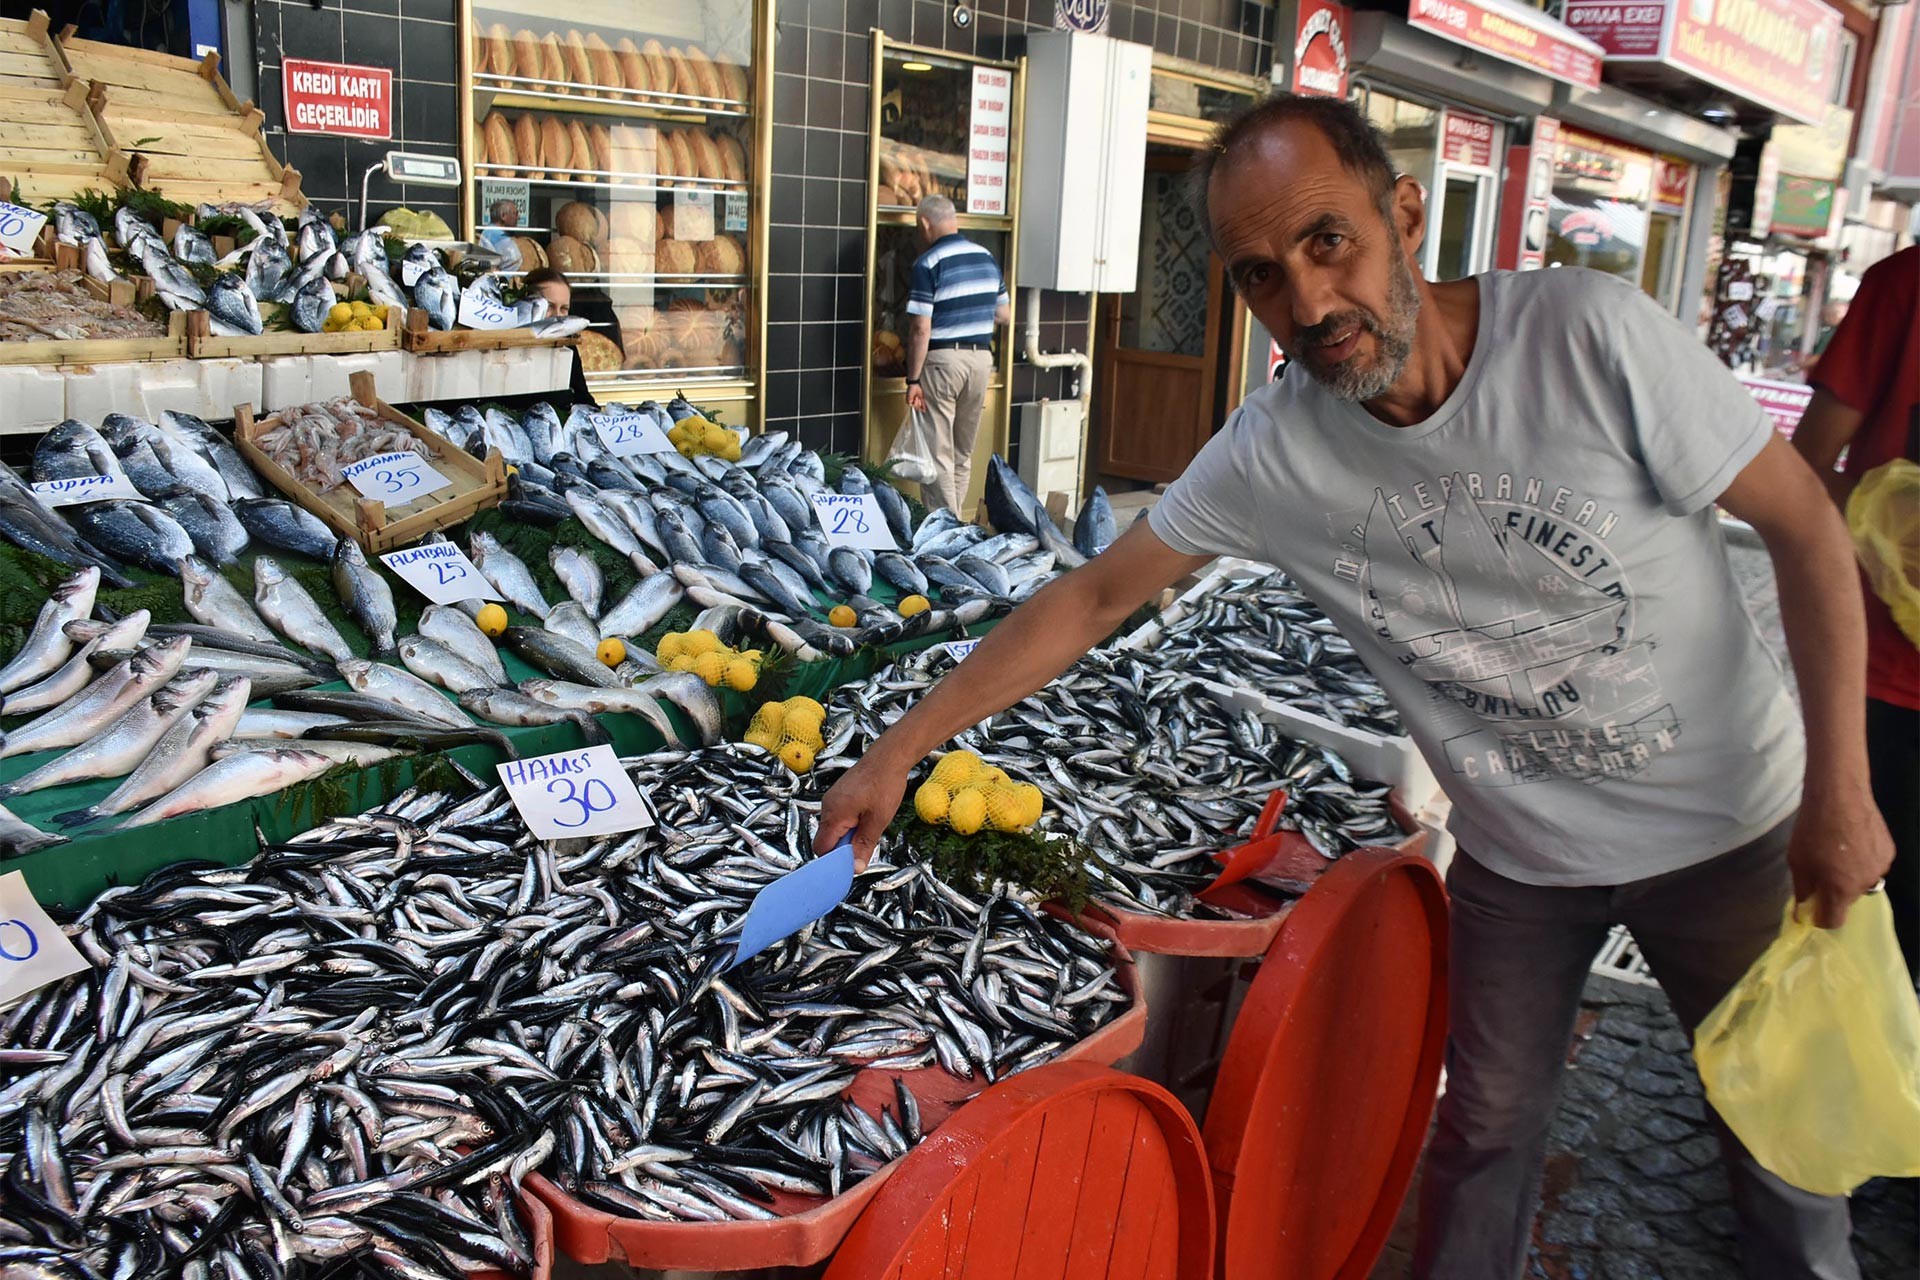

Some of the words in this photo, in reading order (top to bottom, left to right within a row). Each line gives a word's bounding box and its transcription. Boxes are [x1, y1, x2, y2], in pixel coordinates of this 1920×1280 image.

[293, 69, 336, 95] KREDİ
[340, 76, 381, 99] KARTI
[296, 101, 380, 130] GEÇERLİDİR
[474, 307, 503, 323] 40
[609, 424, 644, 443] 28
[375, 464, 421, 493] 35
[831, 507, 870, 534] 28
[1506, 511, 1608, 577] FINEST
[428, 561, 467, 585] 25
[547, 778, 617, 827] 30
